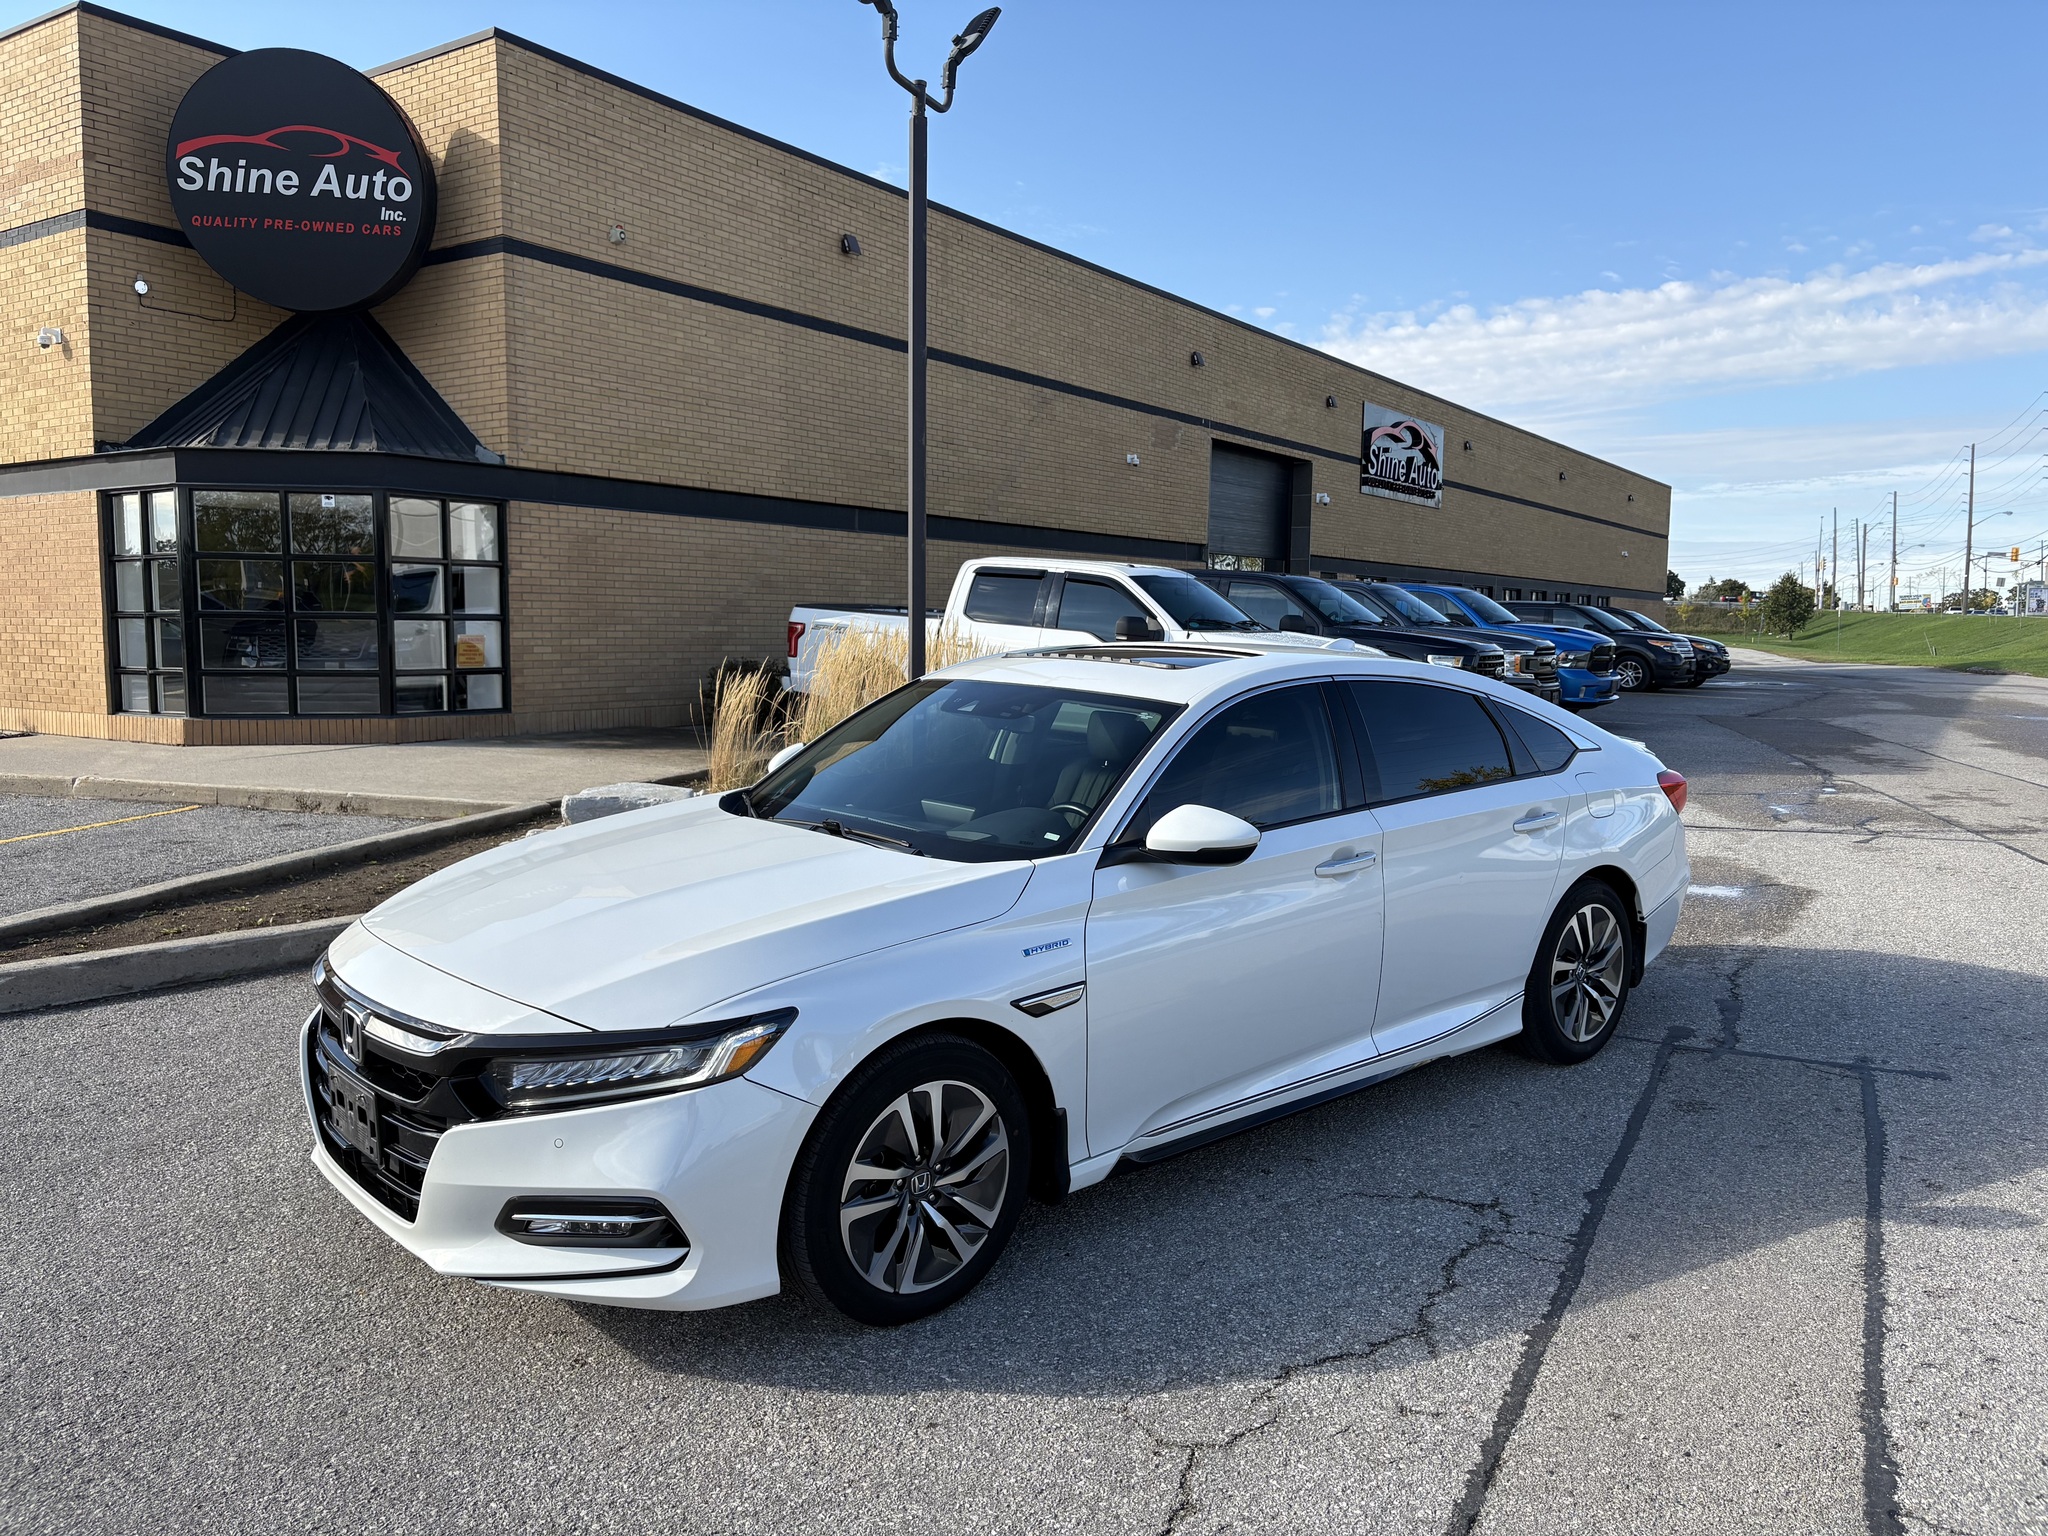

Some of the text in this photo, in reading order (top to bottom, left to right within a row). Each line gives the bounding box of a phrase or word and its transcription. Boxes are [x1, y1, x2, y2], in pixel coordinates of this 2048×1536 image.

[177, 156, 412, 202] Shine Auto
[380, 207, 407, 222] Inc.
[191, 215, 402, 236] QUALITY PRE-OWNED CARS
[1368, 444, 1407, 482] Shine
[1409, 456, 1438, 489] Auto
[1030, 939, 1069, 954] HYBRID
